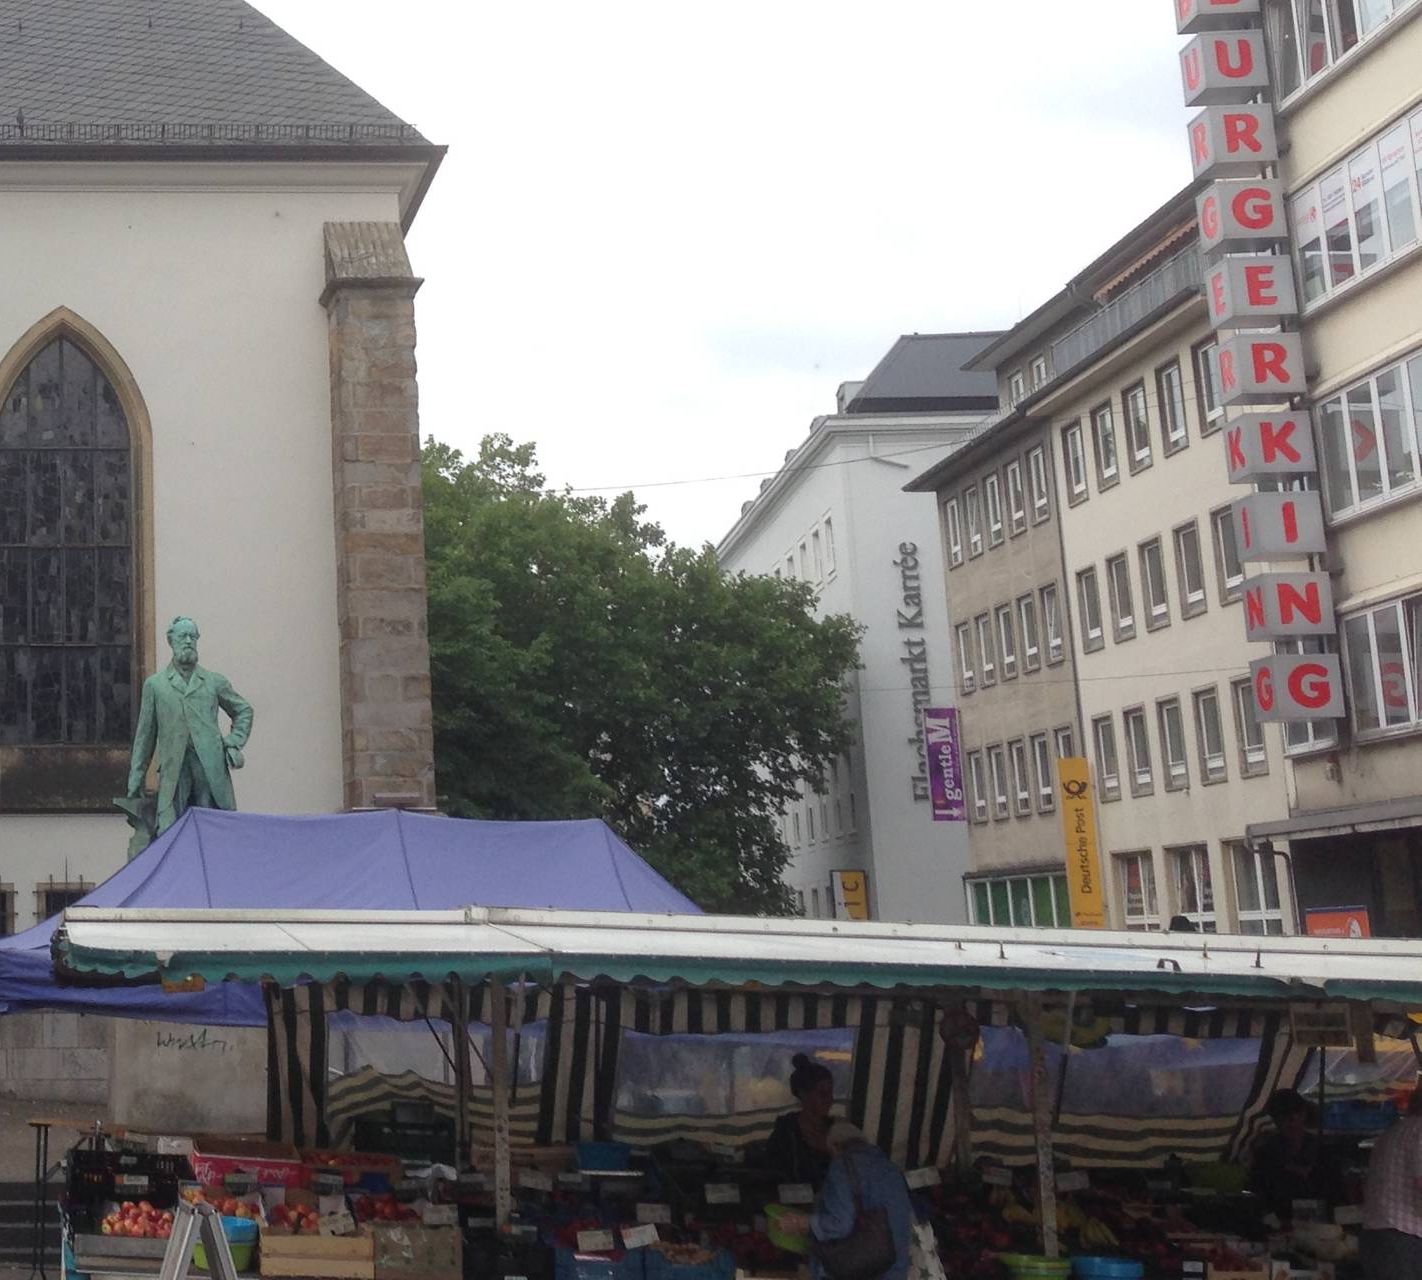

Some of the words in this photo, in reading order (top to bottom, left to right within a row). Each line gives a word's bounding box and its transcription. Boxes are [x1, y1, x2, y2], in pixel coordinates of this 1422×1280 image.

[1209, 0, 1292, 383] URGER
[1260, 420, 1332, 709] KING
[893, 542, 924, 629] Karrée
[1074, 807, 1086, 833] Post
[1077, 837, 1093, 895] Deutsche
